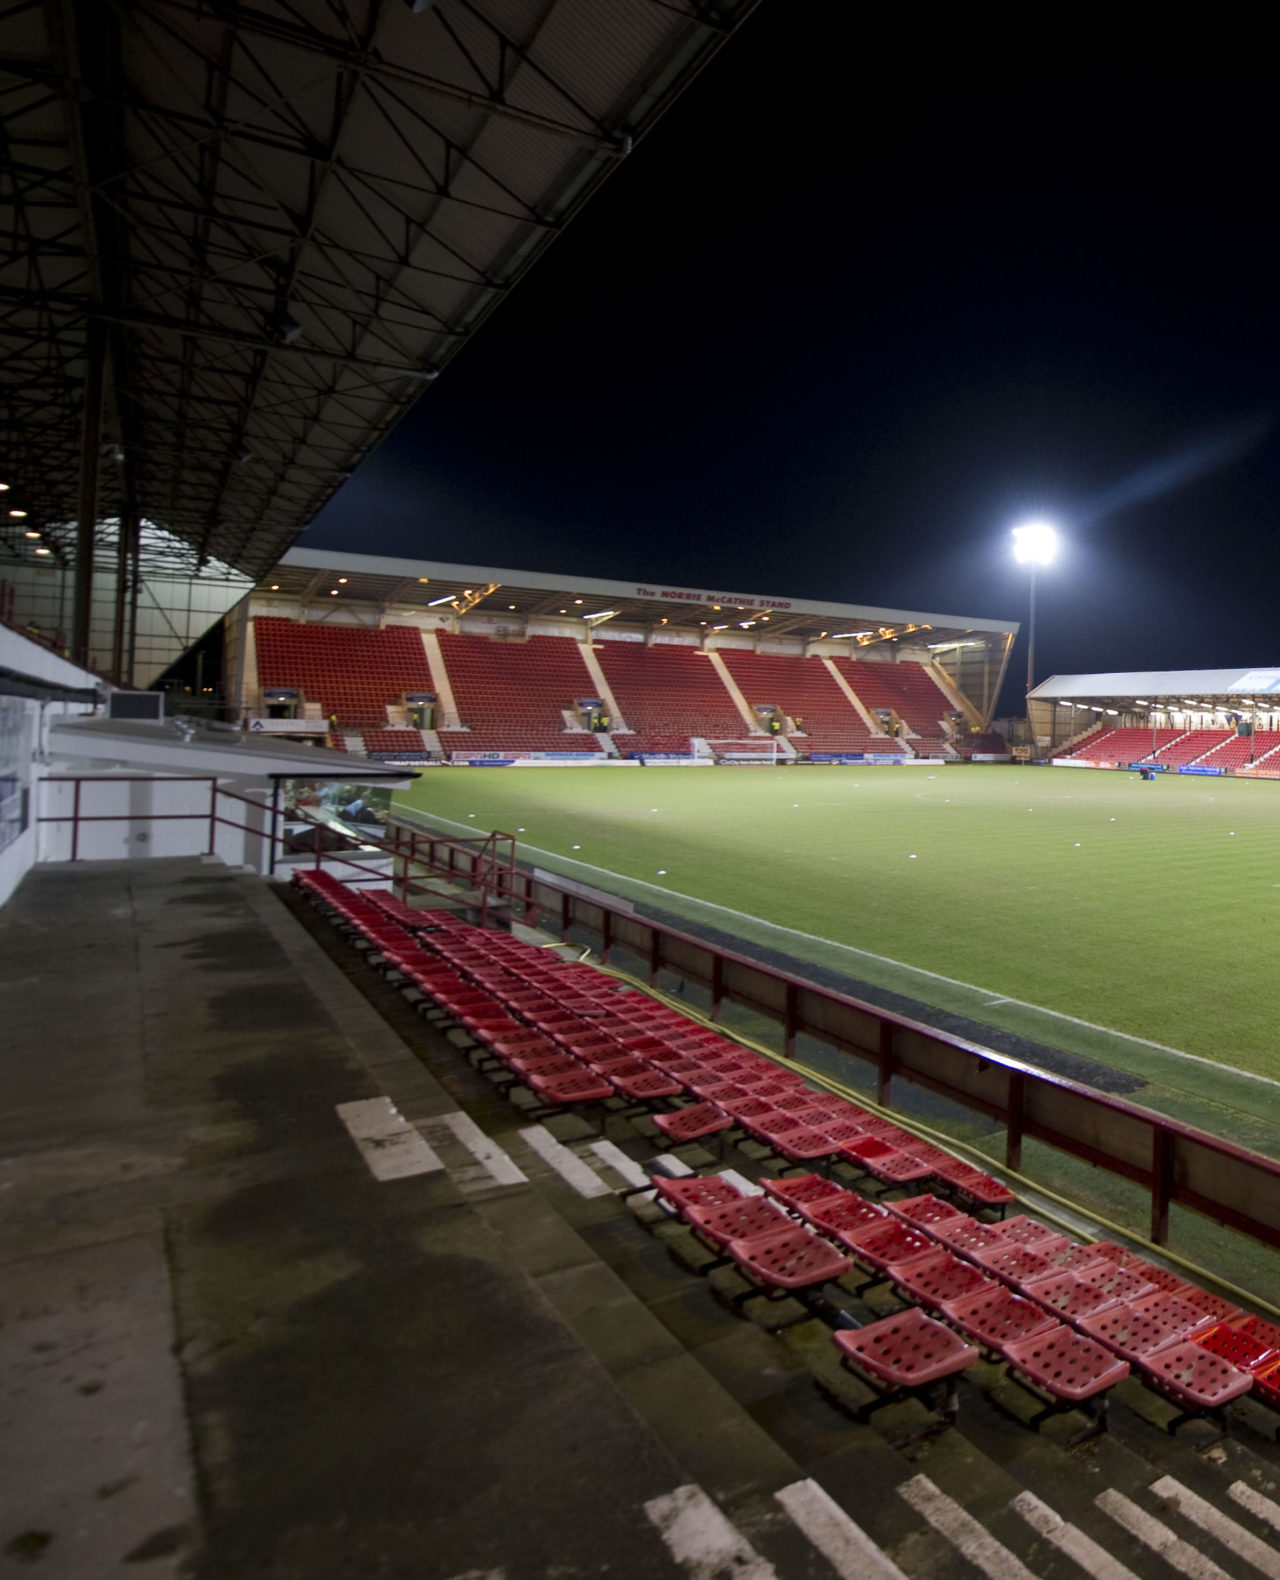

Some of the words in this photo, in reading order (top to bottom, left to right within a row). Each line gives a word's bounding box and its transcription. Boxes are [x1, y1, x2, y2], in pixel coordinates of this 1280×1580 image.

[636, 587, 656, 597] The
[660, 590, 702, 602] NORRIE
[706, 594, 755, 607] McCATHIE
[759, 599, 792, 610] STAND
